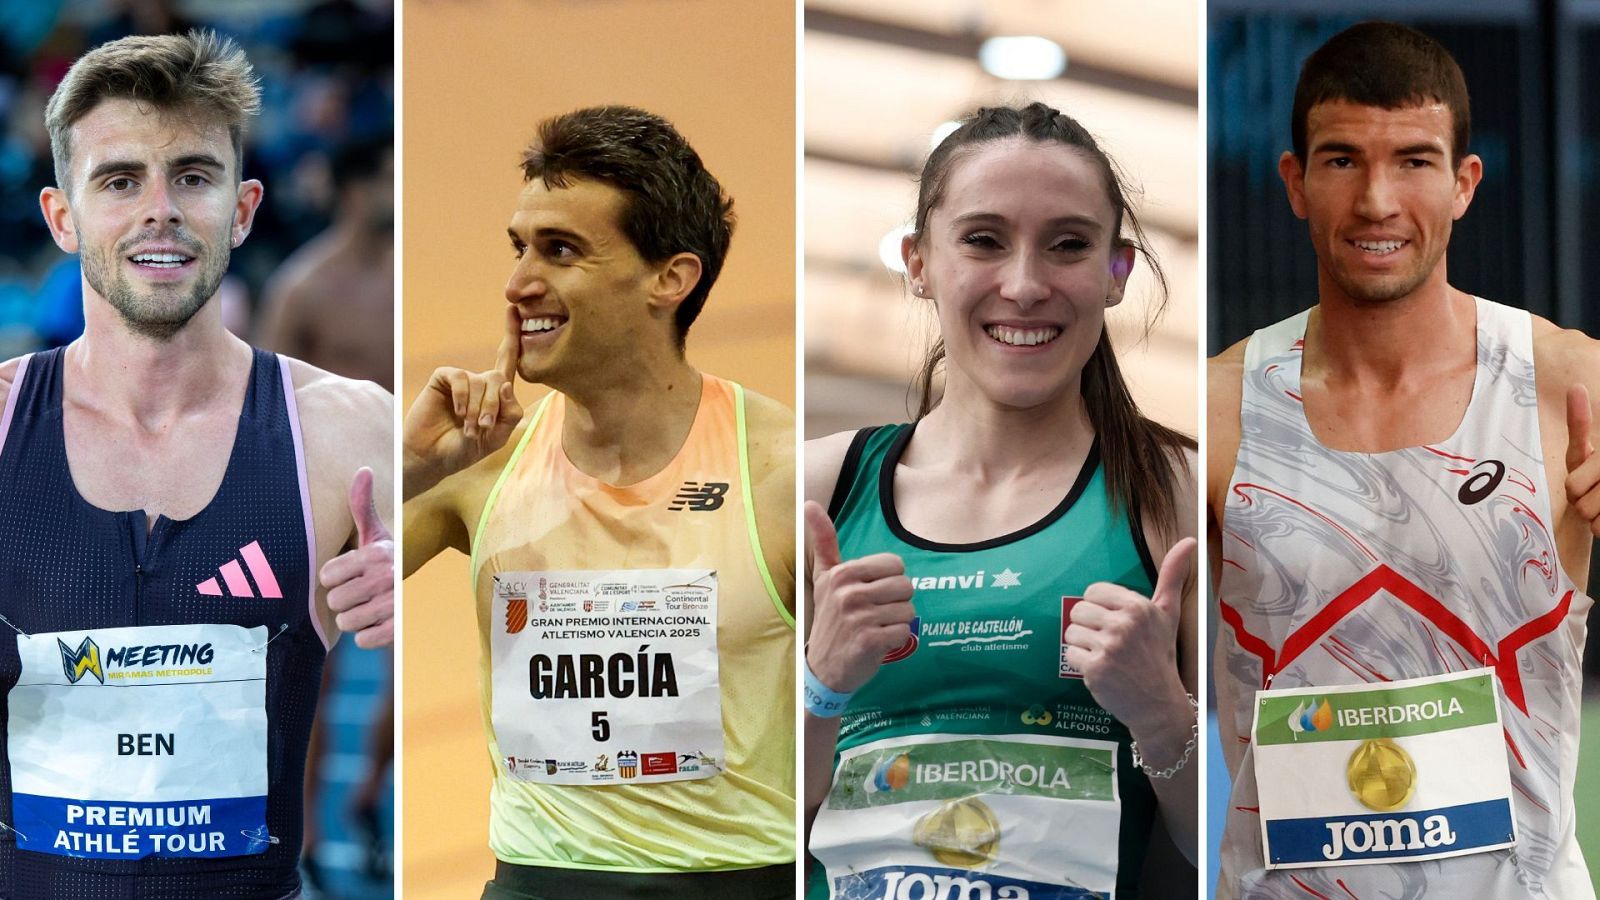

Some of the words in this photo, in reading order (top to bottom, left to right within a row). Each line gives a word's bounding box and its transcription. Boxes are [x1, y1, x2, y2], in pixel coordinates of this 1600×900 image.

[531, 618, 563, 626] GRAN
[565, 617, 610, 626] PREMIO
[612, 616, 711, 625] INTERNACIONAL
[922, 622, 956, 637] PLAYAS
[957, 622, 971, 635] DE
[972, 616, 1024, 635] CASTELLÓN
[541, 630, 606, 639] ATLETISMO
[609, 629, 668, 638] VALENCIA
[670, 628, 701, 637] 2025
[106, 643, 214, 669] MEETING
[961, 644, 982, 652] club
[984, 642, 1029, 651] atletisme
[108, 671, 153, 680] MIRAMAS
[529, 644, 679, 699] GARCÍA
[1056, 711, 1111, 724] TRINIDAD
[1337, 697, 1464, 727] IBERDROLA
[591, 711, 610, 742] 5
[1055, 722, 1109, 733] ALFONSO
[117, 733, 175, 756] BEN
[916, 759, 1071, 790] IBERDROLA
[66, 805, 212, 827] PREMIUM
[54, 830, 140, 853] ATHLÉ
[149, 831, 226, 852] TOUR
